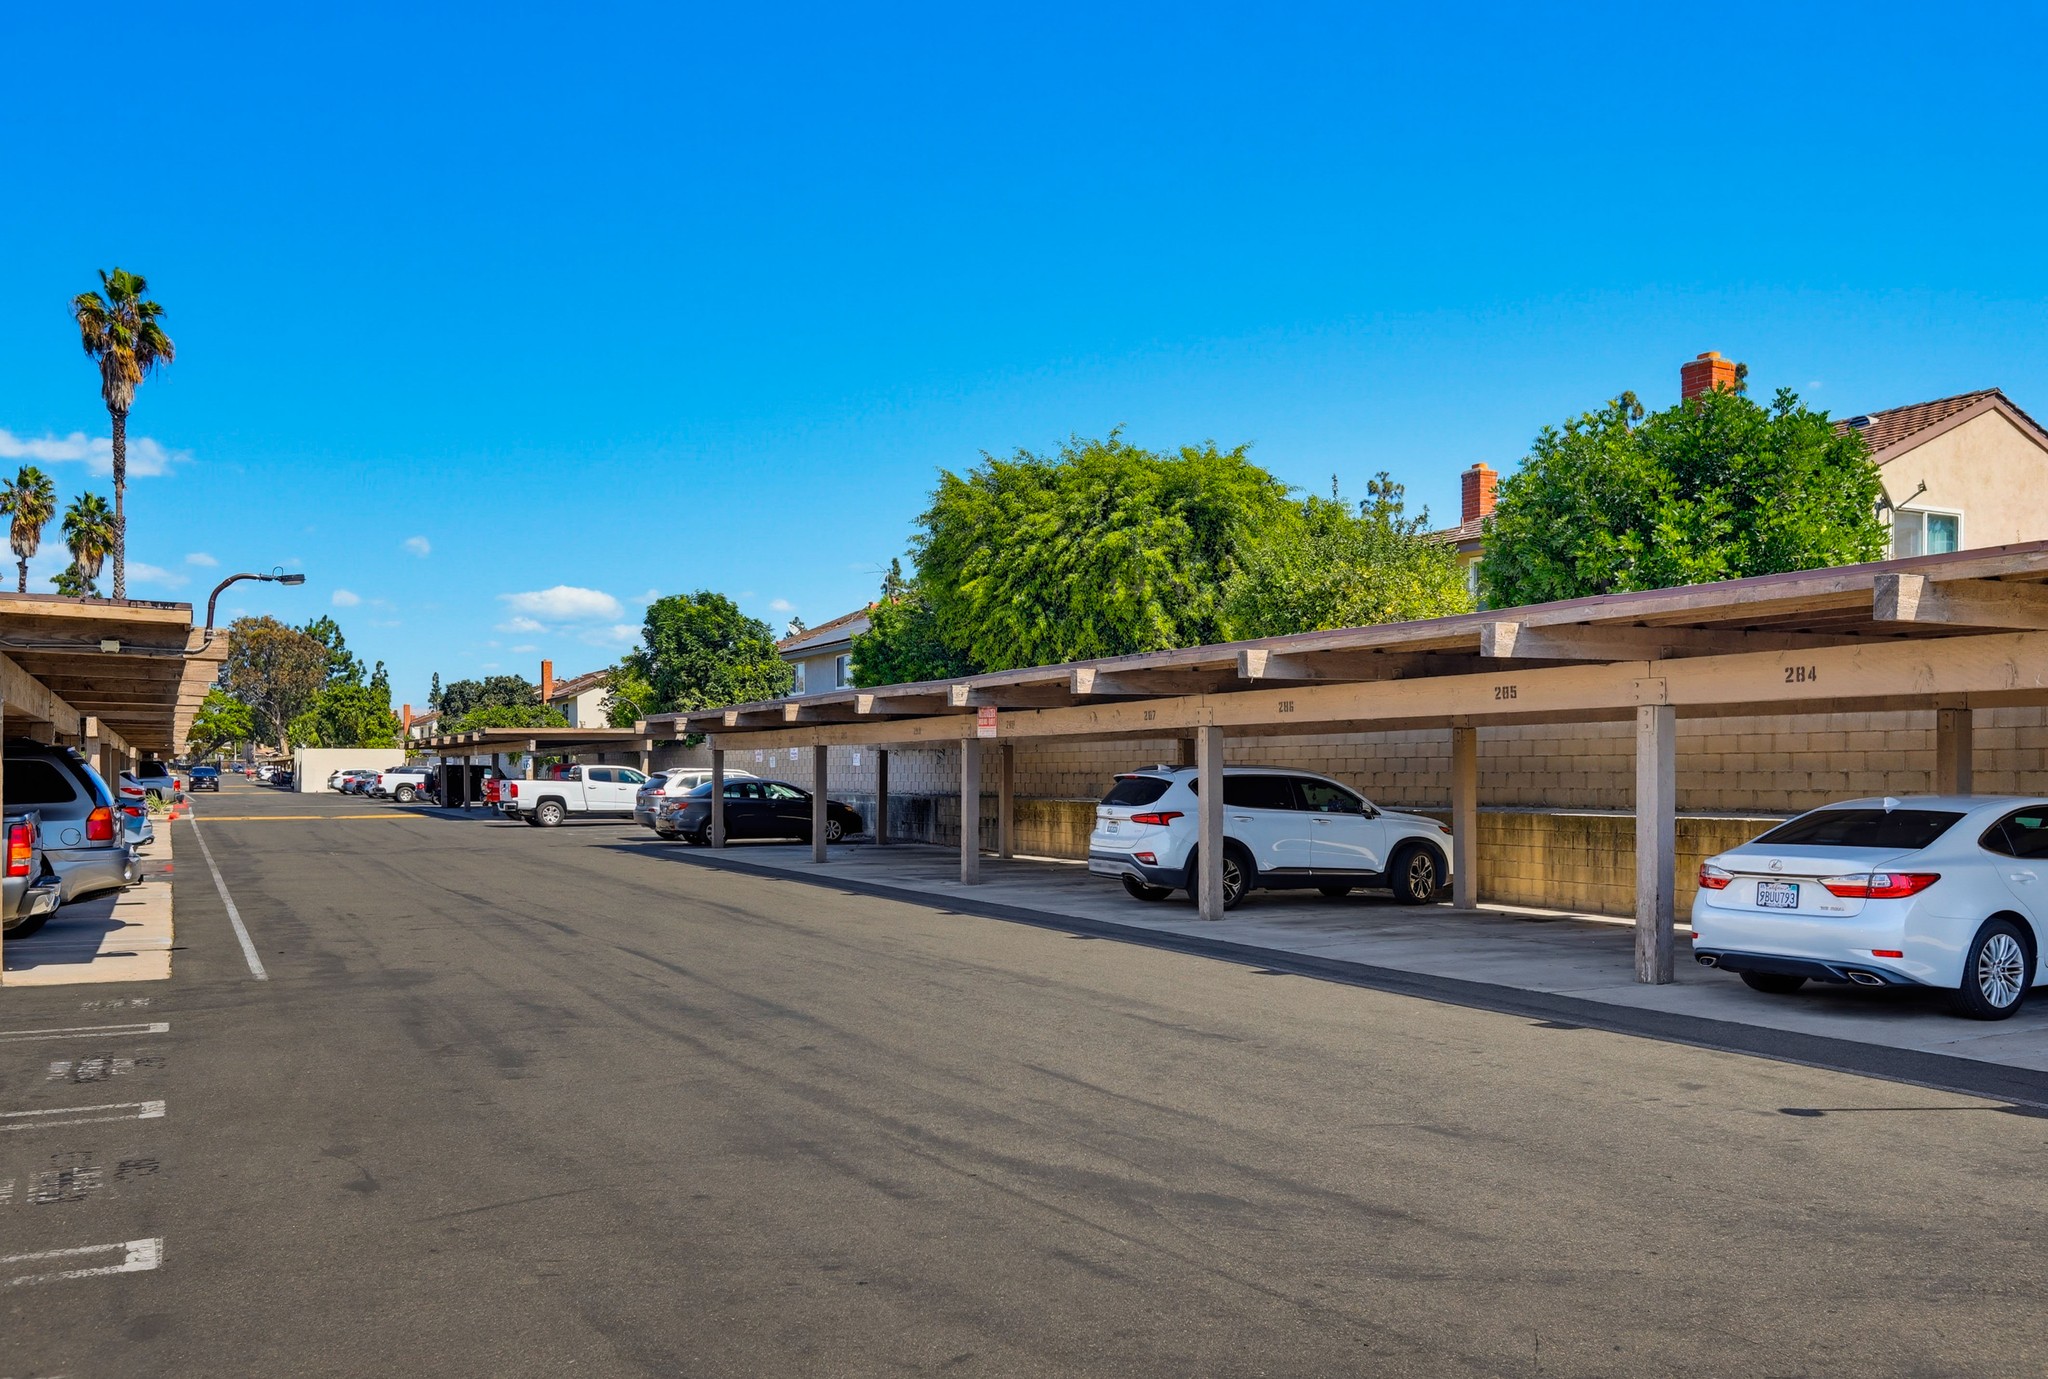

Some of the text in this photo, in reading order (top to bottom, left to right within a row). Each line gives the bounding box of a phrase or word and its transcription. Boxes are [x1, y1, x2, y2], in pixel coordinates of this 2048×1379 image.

[1784, 665, 1817, 683] 284
[1494, 685, 1517, 700] 285
[1278, 700, 1294, 713] 286
[1759, 891, 1795, 904] 9BUU793
